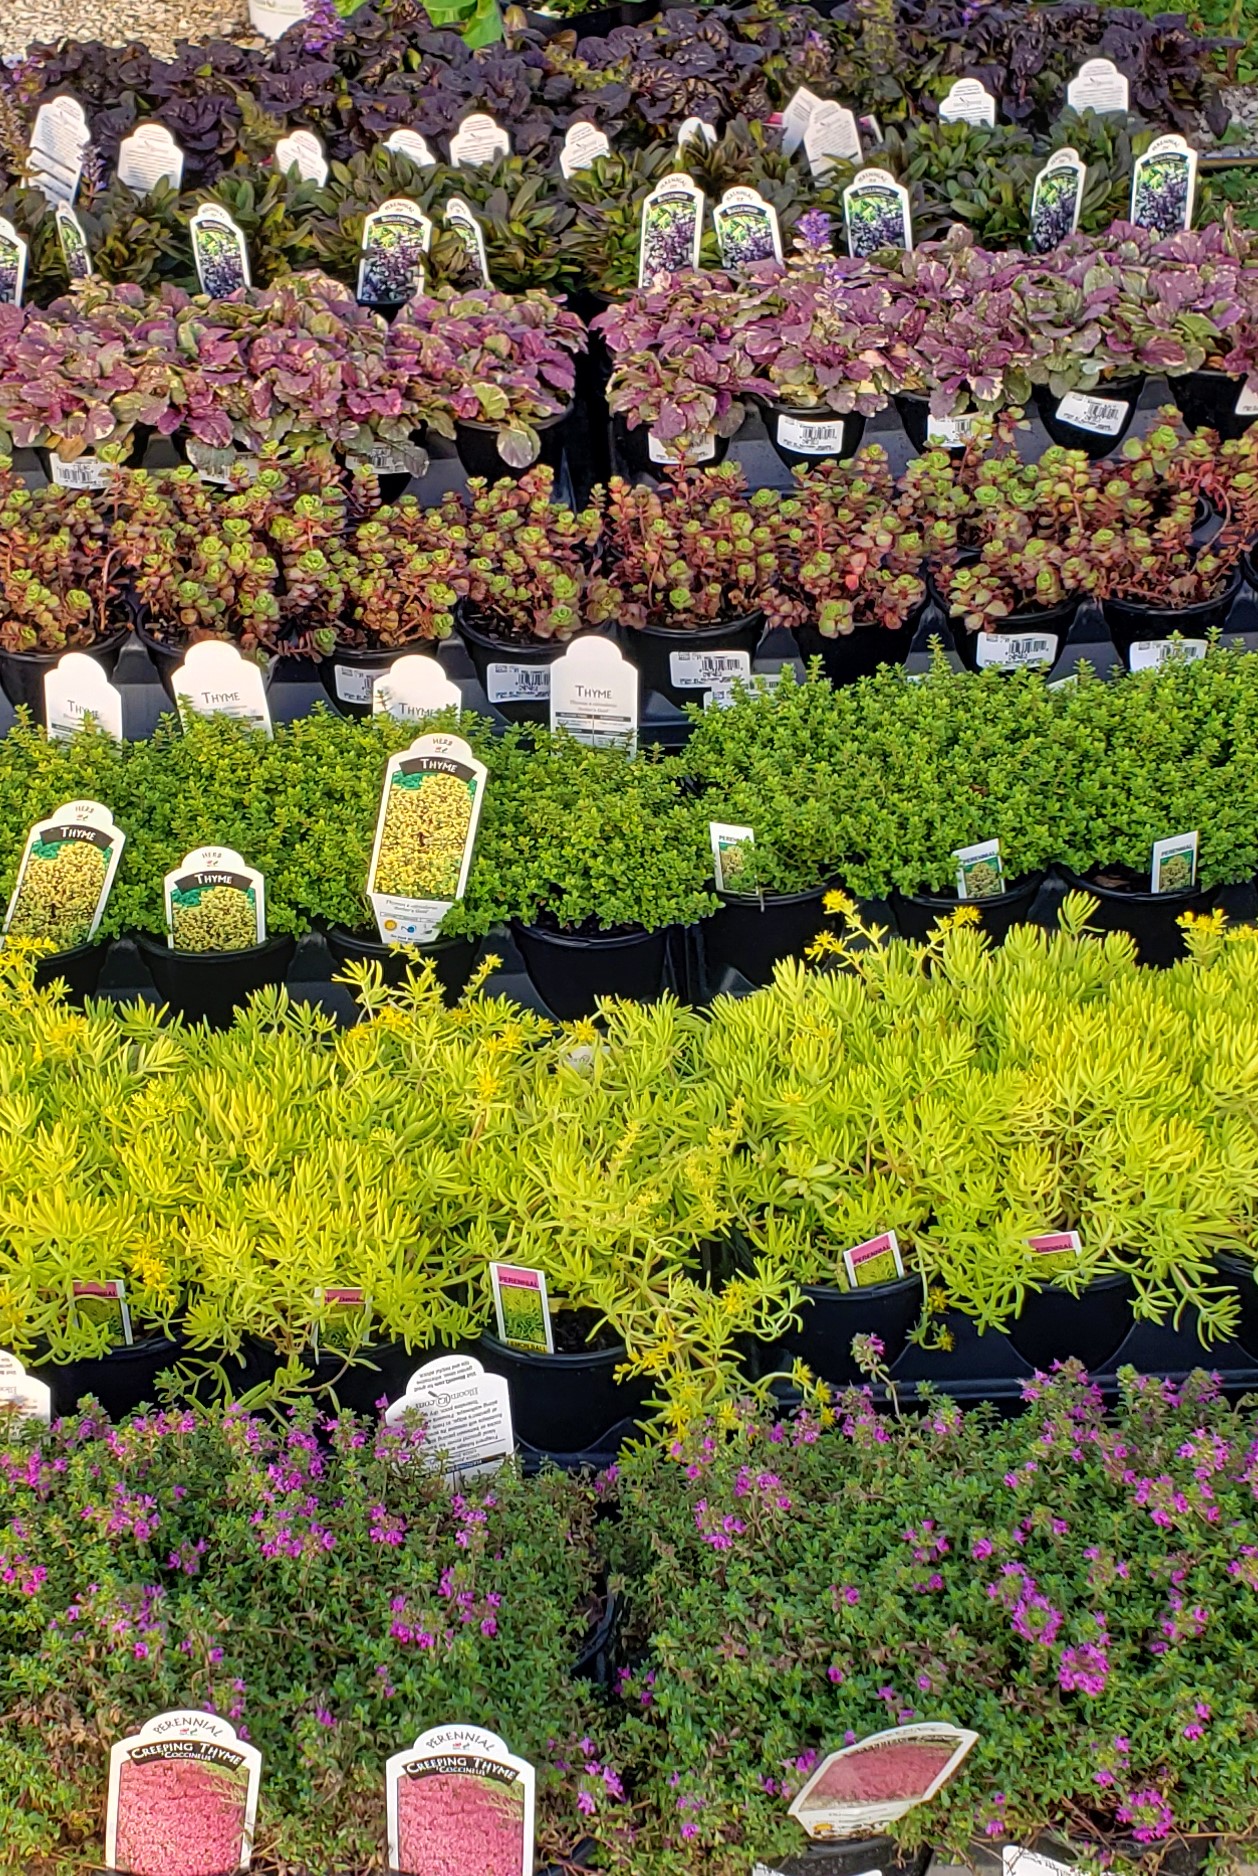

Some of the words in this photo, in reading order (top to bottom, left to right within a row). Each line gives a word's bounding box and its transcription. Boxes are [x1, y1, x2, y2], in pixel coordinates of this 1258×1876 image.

[200, 691, 241, 704] THYME
[575, 684, 613, 699] THYME
[420, 758, 458, 773] THYME
[60, 827, 97, 841] THYME
[194, 873, 233, 885] THYME
[499, 1276, 540, 1289] PERENNIAL
[153, 1717, 223, 1737] PERENNIAL
[425, 1731, 495, 1751] PERENNIAL
[131, 1742, 193, 1758] CREEPING
[200, 1743, 242, 1765] THYME
[406, 1757, 467, 1773] CREEPING
[473, 1757, 516, 1780] THYME
